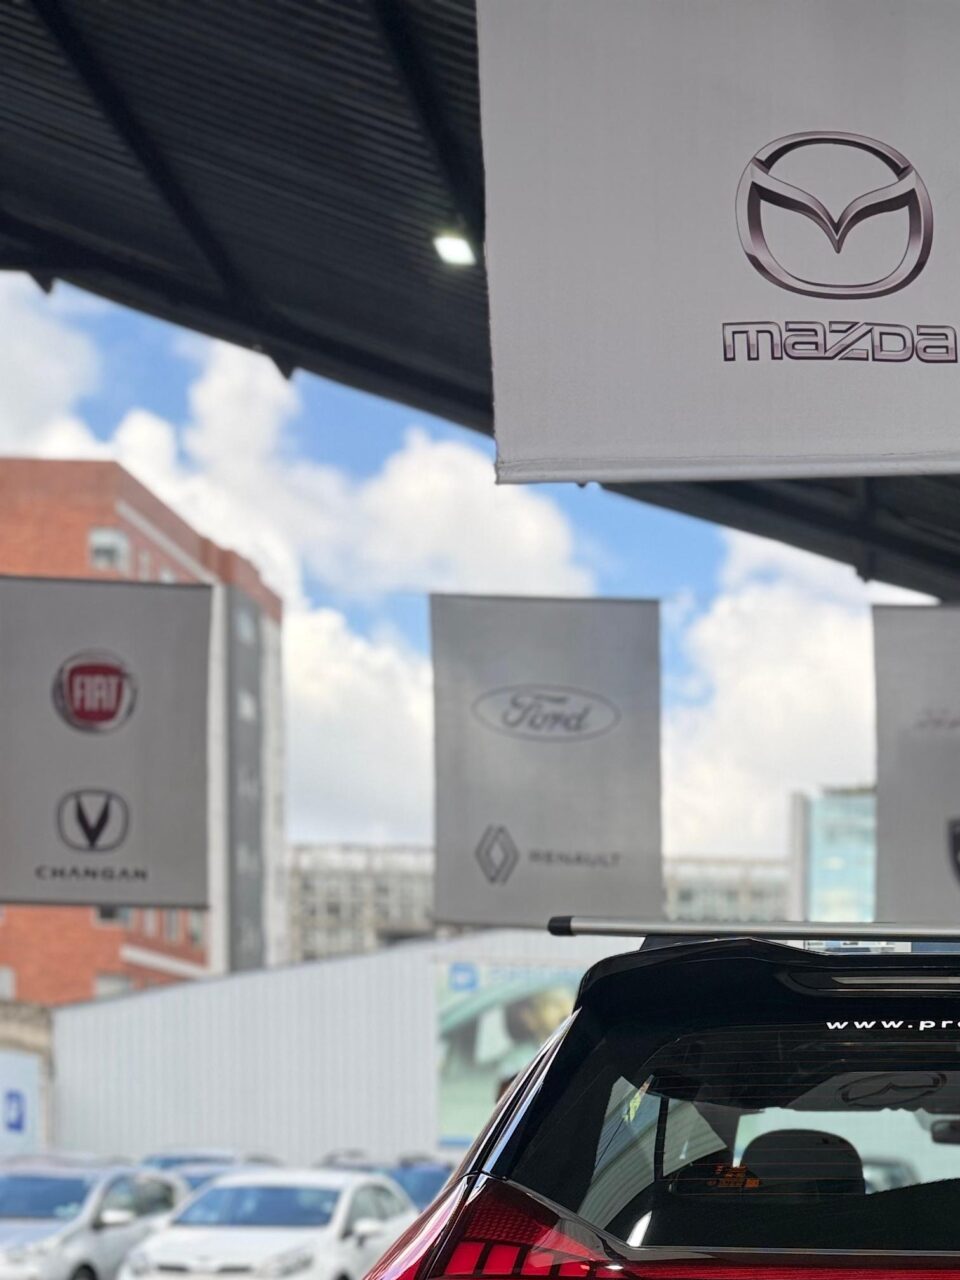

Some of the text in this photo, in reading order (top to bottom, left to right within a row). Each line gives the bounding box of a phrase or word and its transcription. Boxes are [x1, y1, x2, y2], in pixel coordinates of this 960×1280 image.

[72, 674, 121, 712] FIAT
[502, 694, 593, 733] Ford
[35, 866, 148, 881] CHANGAN
